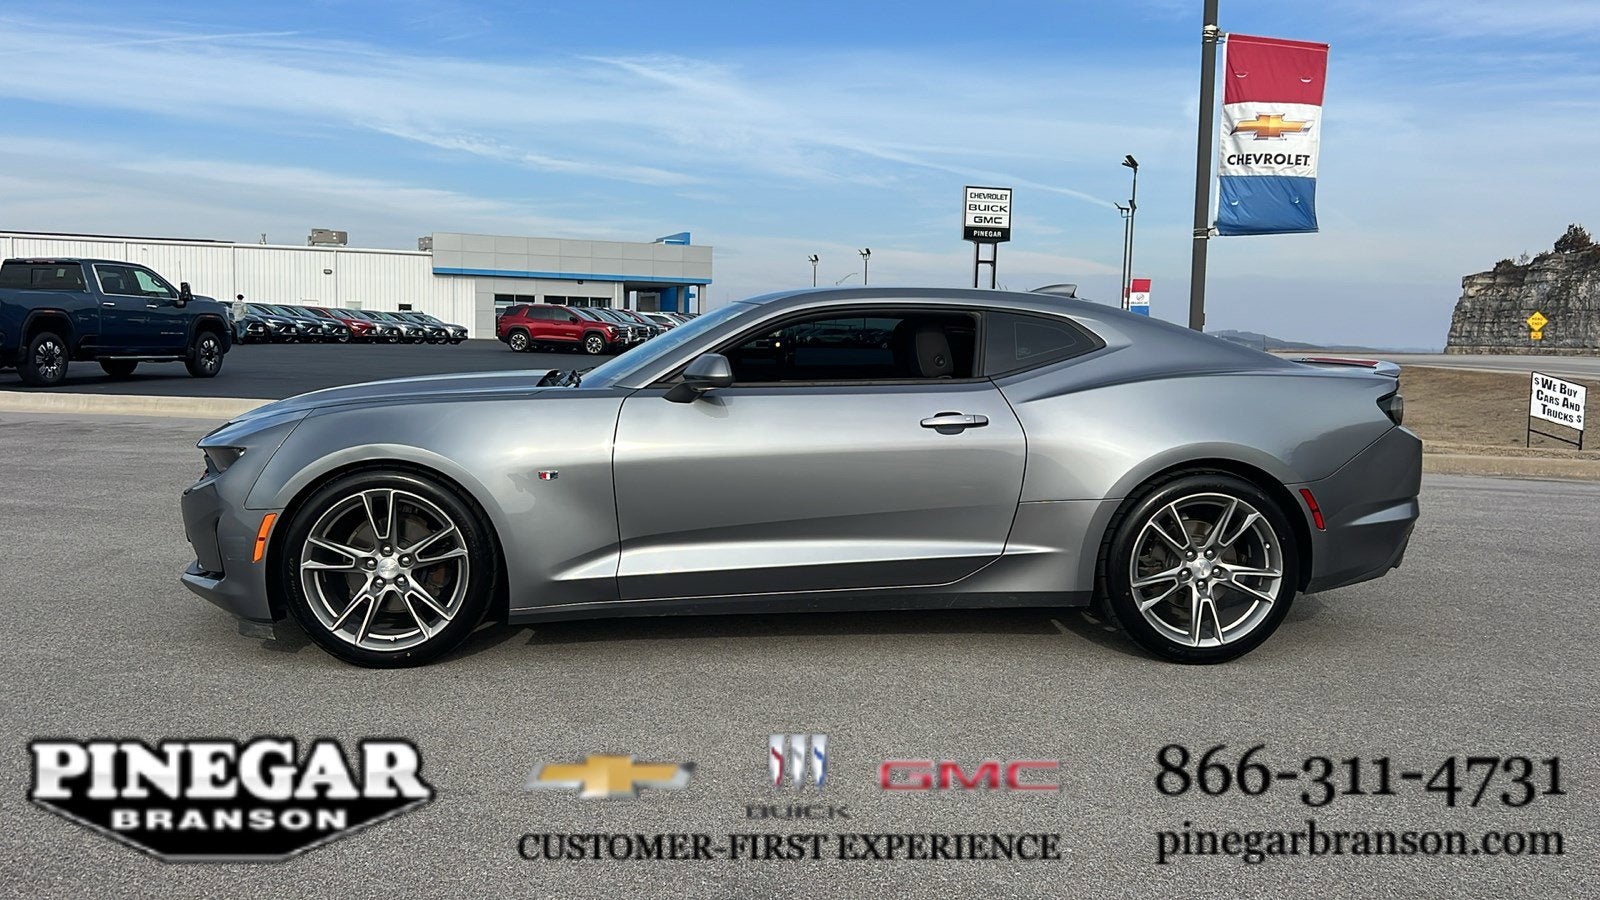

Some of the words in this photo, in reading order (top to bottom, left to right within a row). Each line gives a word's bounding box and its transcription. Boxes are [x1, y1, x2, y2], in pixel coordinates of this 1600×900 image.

[1227, 153, 1310, 166] CHEVROLET
[970, 192, 1008, 200] CHEVROLET
[969, 204, 1007, 212] BUICK
[974, 216, 1002, 224] GMC
[1541, 378, 1556, 392] WE
[1560, 383, 1577, 397] BUY
[1536, 389, 1560, 406] CARS
[1562, 398, 1581, 412] AND
[1541, 403, 1574, 423] TRUCKS
